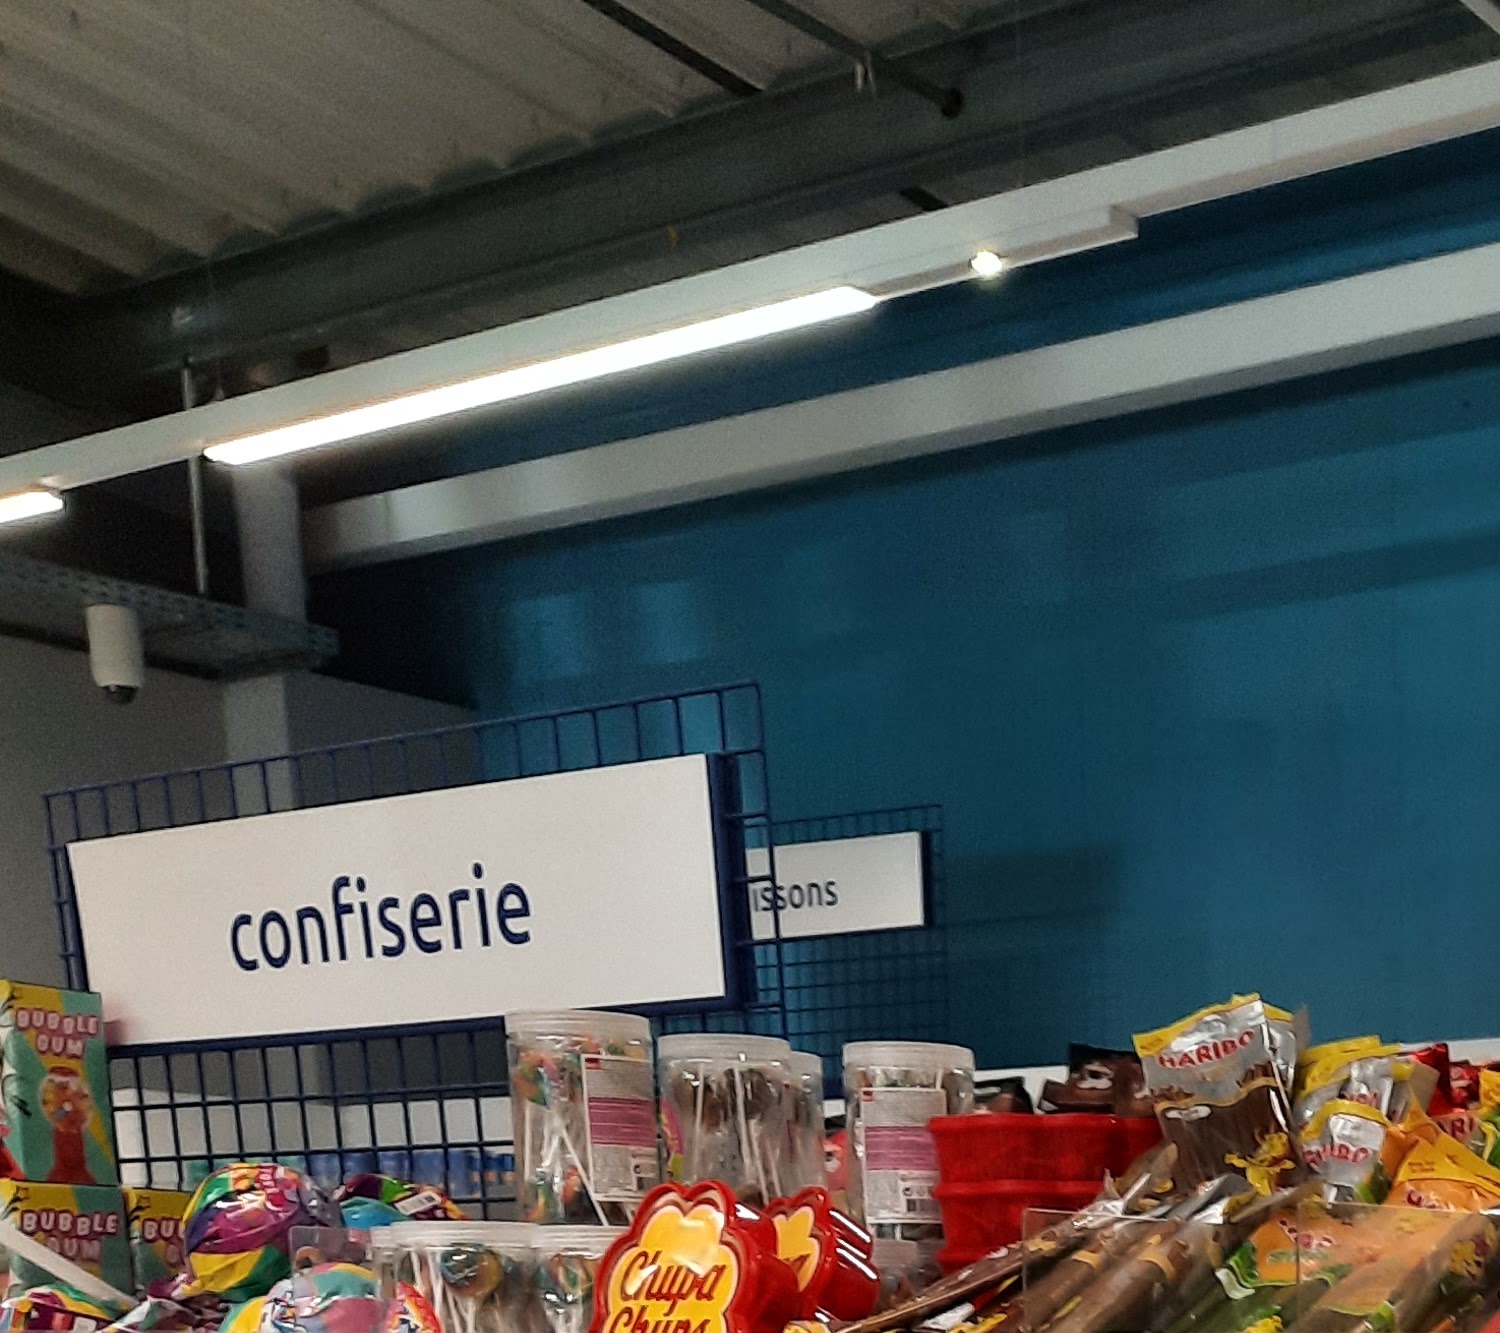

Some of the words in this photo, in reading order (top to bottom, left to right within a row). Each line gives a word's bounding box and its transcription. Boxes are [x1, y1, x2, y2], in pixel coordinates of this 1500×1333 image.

[230, 862, 533, 972] confiserie
[1158, 1030, 1256, 1068] HARIBO
[22, 1210, 119, 1236] BUBBLE
